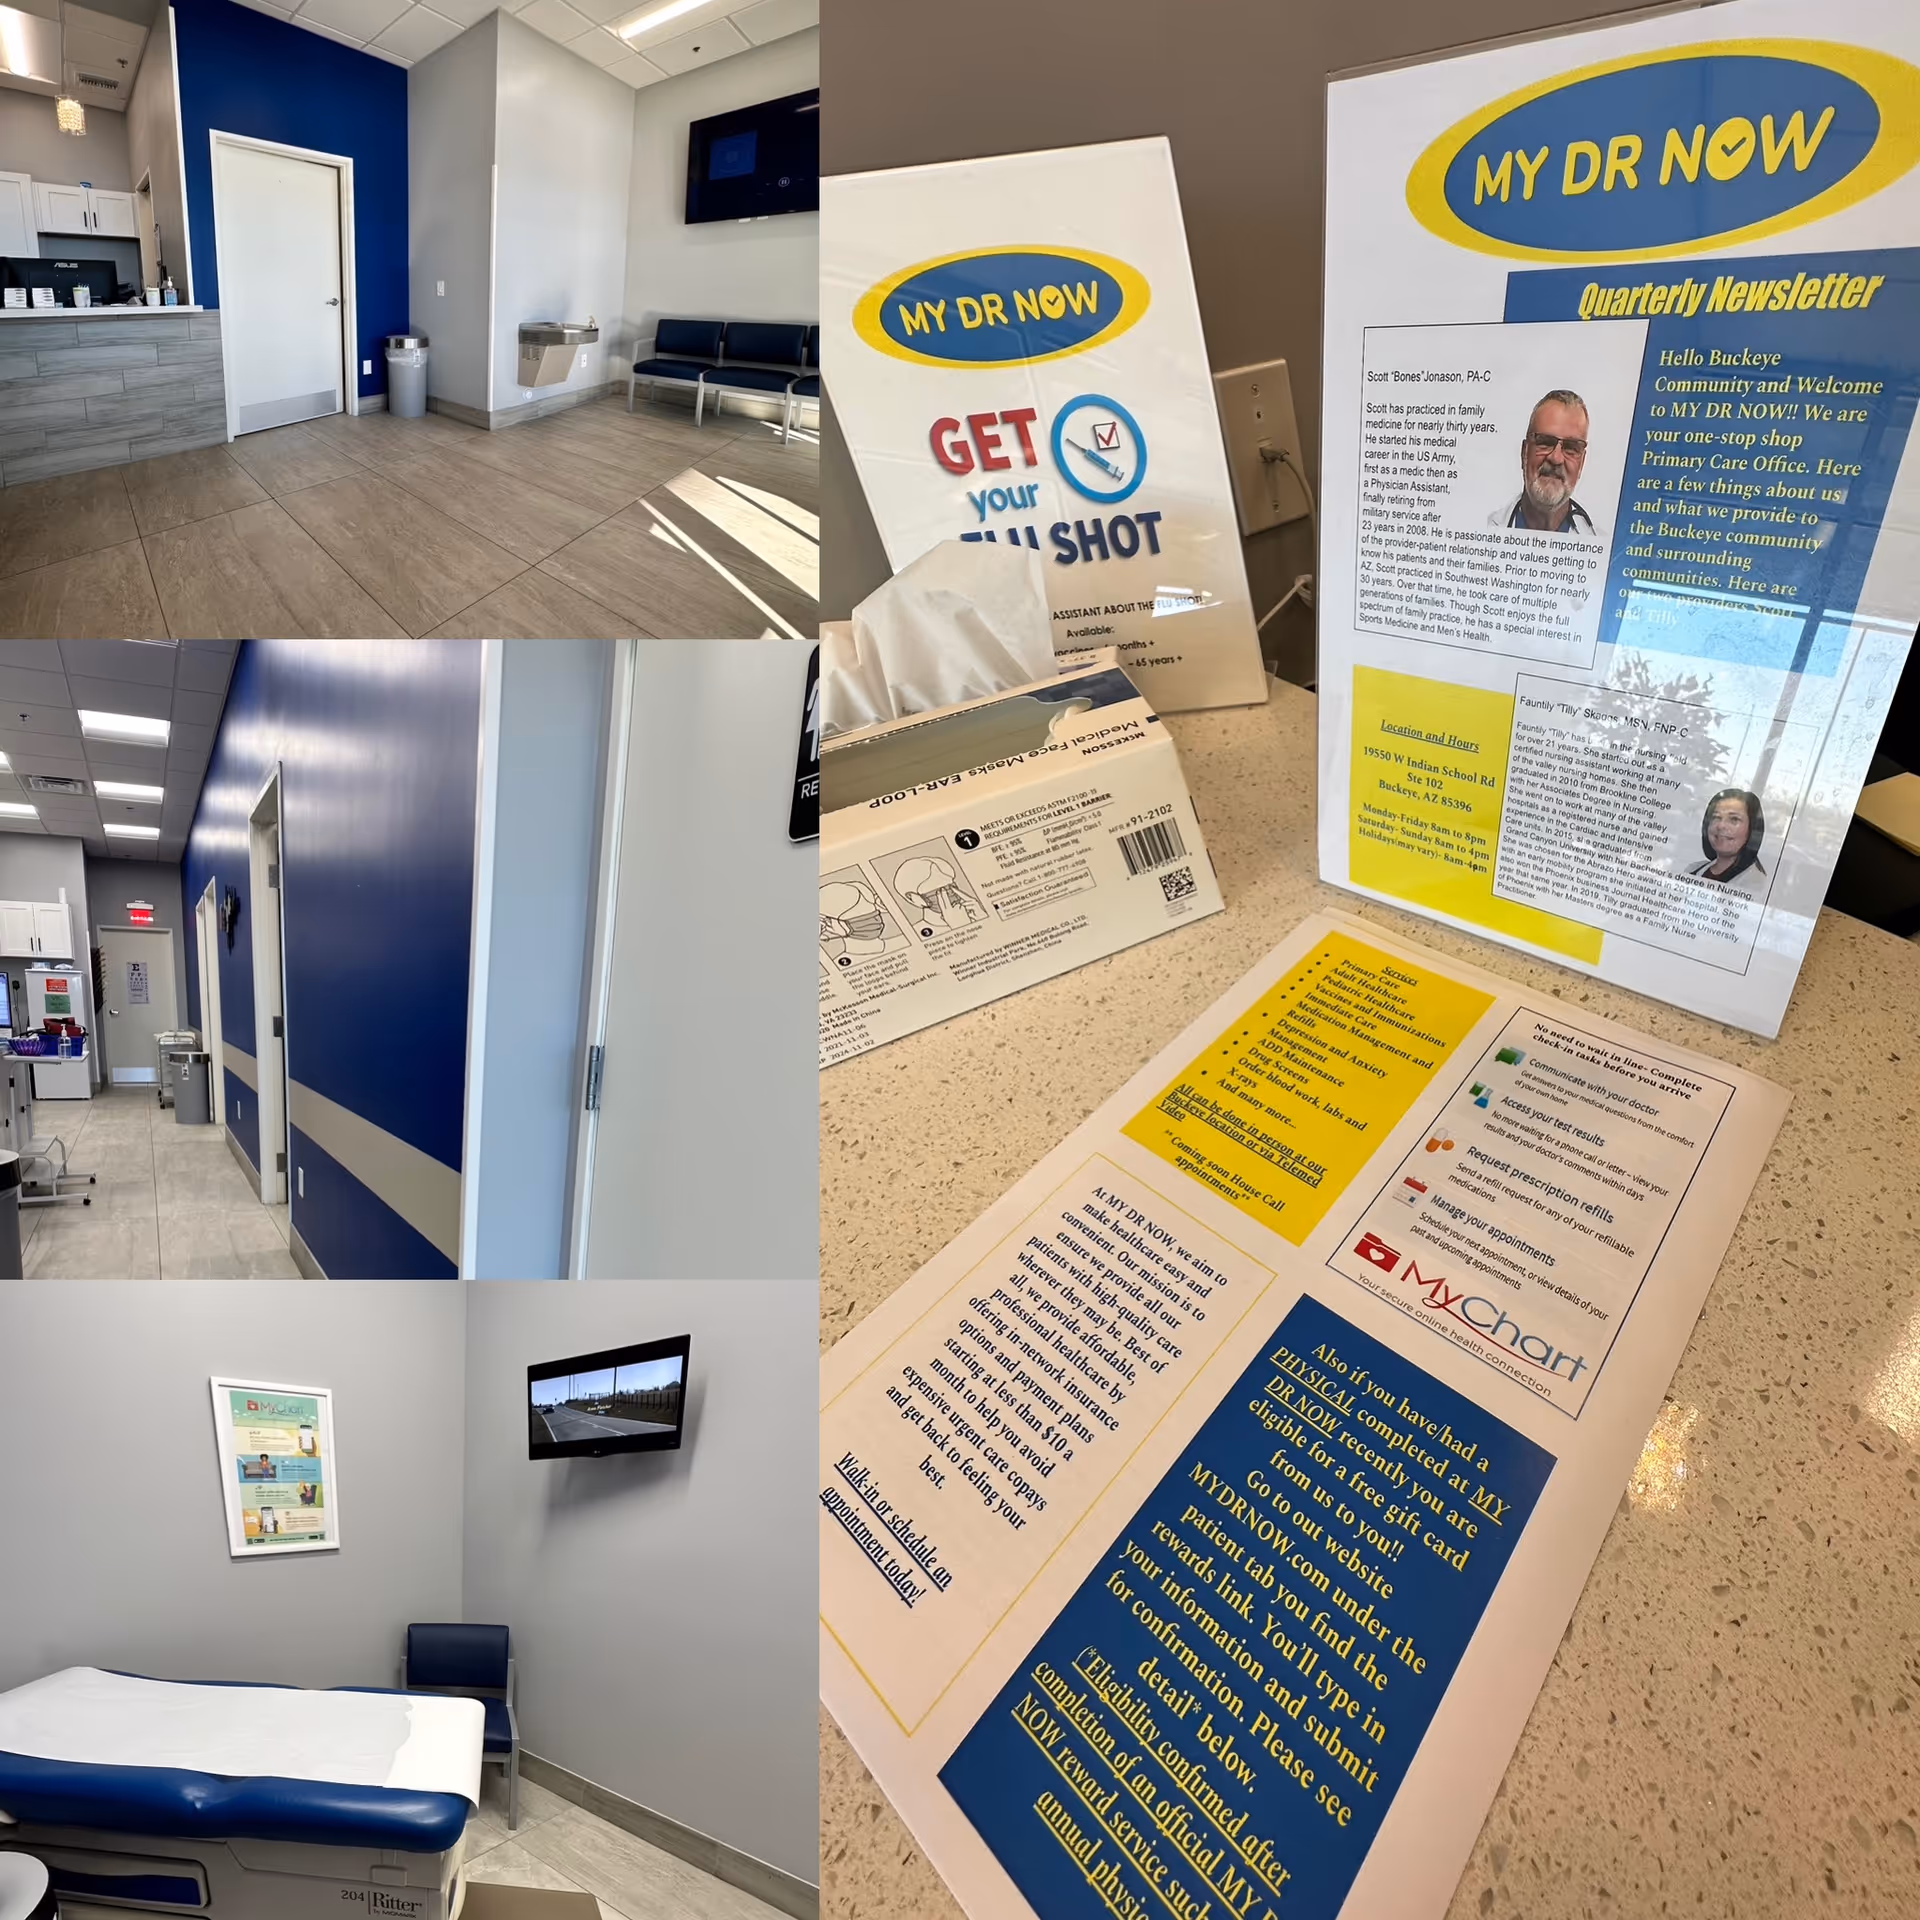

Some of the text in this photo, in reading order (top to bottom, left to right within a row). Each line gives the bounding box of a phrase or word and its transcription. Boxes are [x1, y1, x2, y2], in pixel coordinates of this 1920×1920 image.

[1473, 104, 1836, 206] MY DR NOW
[898, 279, 1099, 336] MY DR NOW
[1577, 271, 1886, 322] Quarterly Newsletter
[1367, 370, 1389, 382] Scott
[1466, 370, 1492, 382] PA-C
[1658, 346, 1783, 371] Hello Buckeye
[1654, 374, 1884, 397] Community and Welcome
[1365, 418, 1498, 435] medicine for nearly thirty years.
[1366, 402, 1486, 419] Scott has practiced in family
[1649, 401, 1868, 423] to MY DR NOW!! We are
[928, 407, 1039, 477] GET
[1641, 449, 1863, 478] Primary Care Office. Here
[966, 482, 1039, 523] your
[1049, 510, 1163, 566] SHOT
[1052, 606, 1102, 621] ASSISTANT
[1104, 603, 1137, 615] ABOUT
[1137, 600, 1155, 612] THE
[1359, 612, 1493, 643] Sports Medicine and Men's Health.
[1066, 625, 1115, 639] Available:
[1135, 654, 1175, 668] 65 years
[1380, 719, 1480, 753] Location and Hours
[868, 718, 1140, 811] Medical Face Masks EAR-LOOP
[1363, 746, 1496, 789] 19550 W Indian School Rd
[1406, 772, 1444, 790] Ste 102
[1513, 743, 1682, 790] certified nursing assistant working at many
[1052, 805, 1076, 818] LEVEL
[1081, 792, 1112, 808] BARRIER
[1378, 778, 1473, 813] Buckeye, AZ 85396
[979, 798, 1067, 833] MEETS OR EXCEEDS ASTM
[1130, 803, 1173, 826] 91-2102
[1362, 802, 1487, 847] Monday-Friday 8am to 8pm
[999, 871, 1090, 908] Satisfaction Guaranteed
[1496, 881, 1537, 901] Practitioner.
[131, 963, 140, 971] E
[1340, 958, 1401, 990] Primary Care
[1380, 965, 1419, 987] Services
[1322, 974, 1416, 1022] Pediatric Healthcare
[1330, 966, 1408, 1005] Adult Healthcare
[1225, 1065, 1259, 1090] X-rays
[1247, 1046, 1310, 1085] Drug Screens
[1528, 1057, 1661, 1117] Communicate with your doctor
[1466, 1145, 1616, 1225] Request prescription refills
[1091, 1186, 1228, 1287] At MY DR NOW, we aim to
[1357, 1272, 1552, 1397] Your secure online health connection
[1400, 1259, 1589, 1383] MyChart
[918, 1454, 948, 1490] best.
[837, 1450, 953, 1588] Walk-in or schedule an
[1245, 1468, 1395, 1600] Go to out website
[821, 1486, 928, 1604] appointment today!
[1187, 1460, 1429, 1676] MYDRNOW.com under the
[1195, 1713, 1258, 1794] below.
[340, 1889, 365, 1901] 204
[371, 1891, 421, 1912] Ritter
